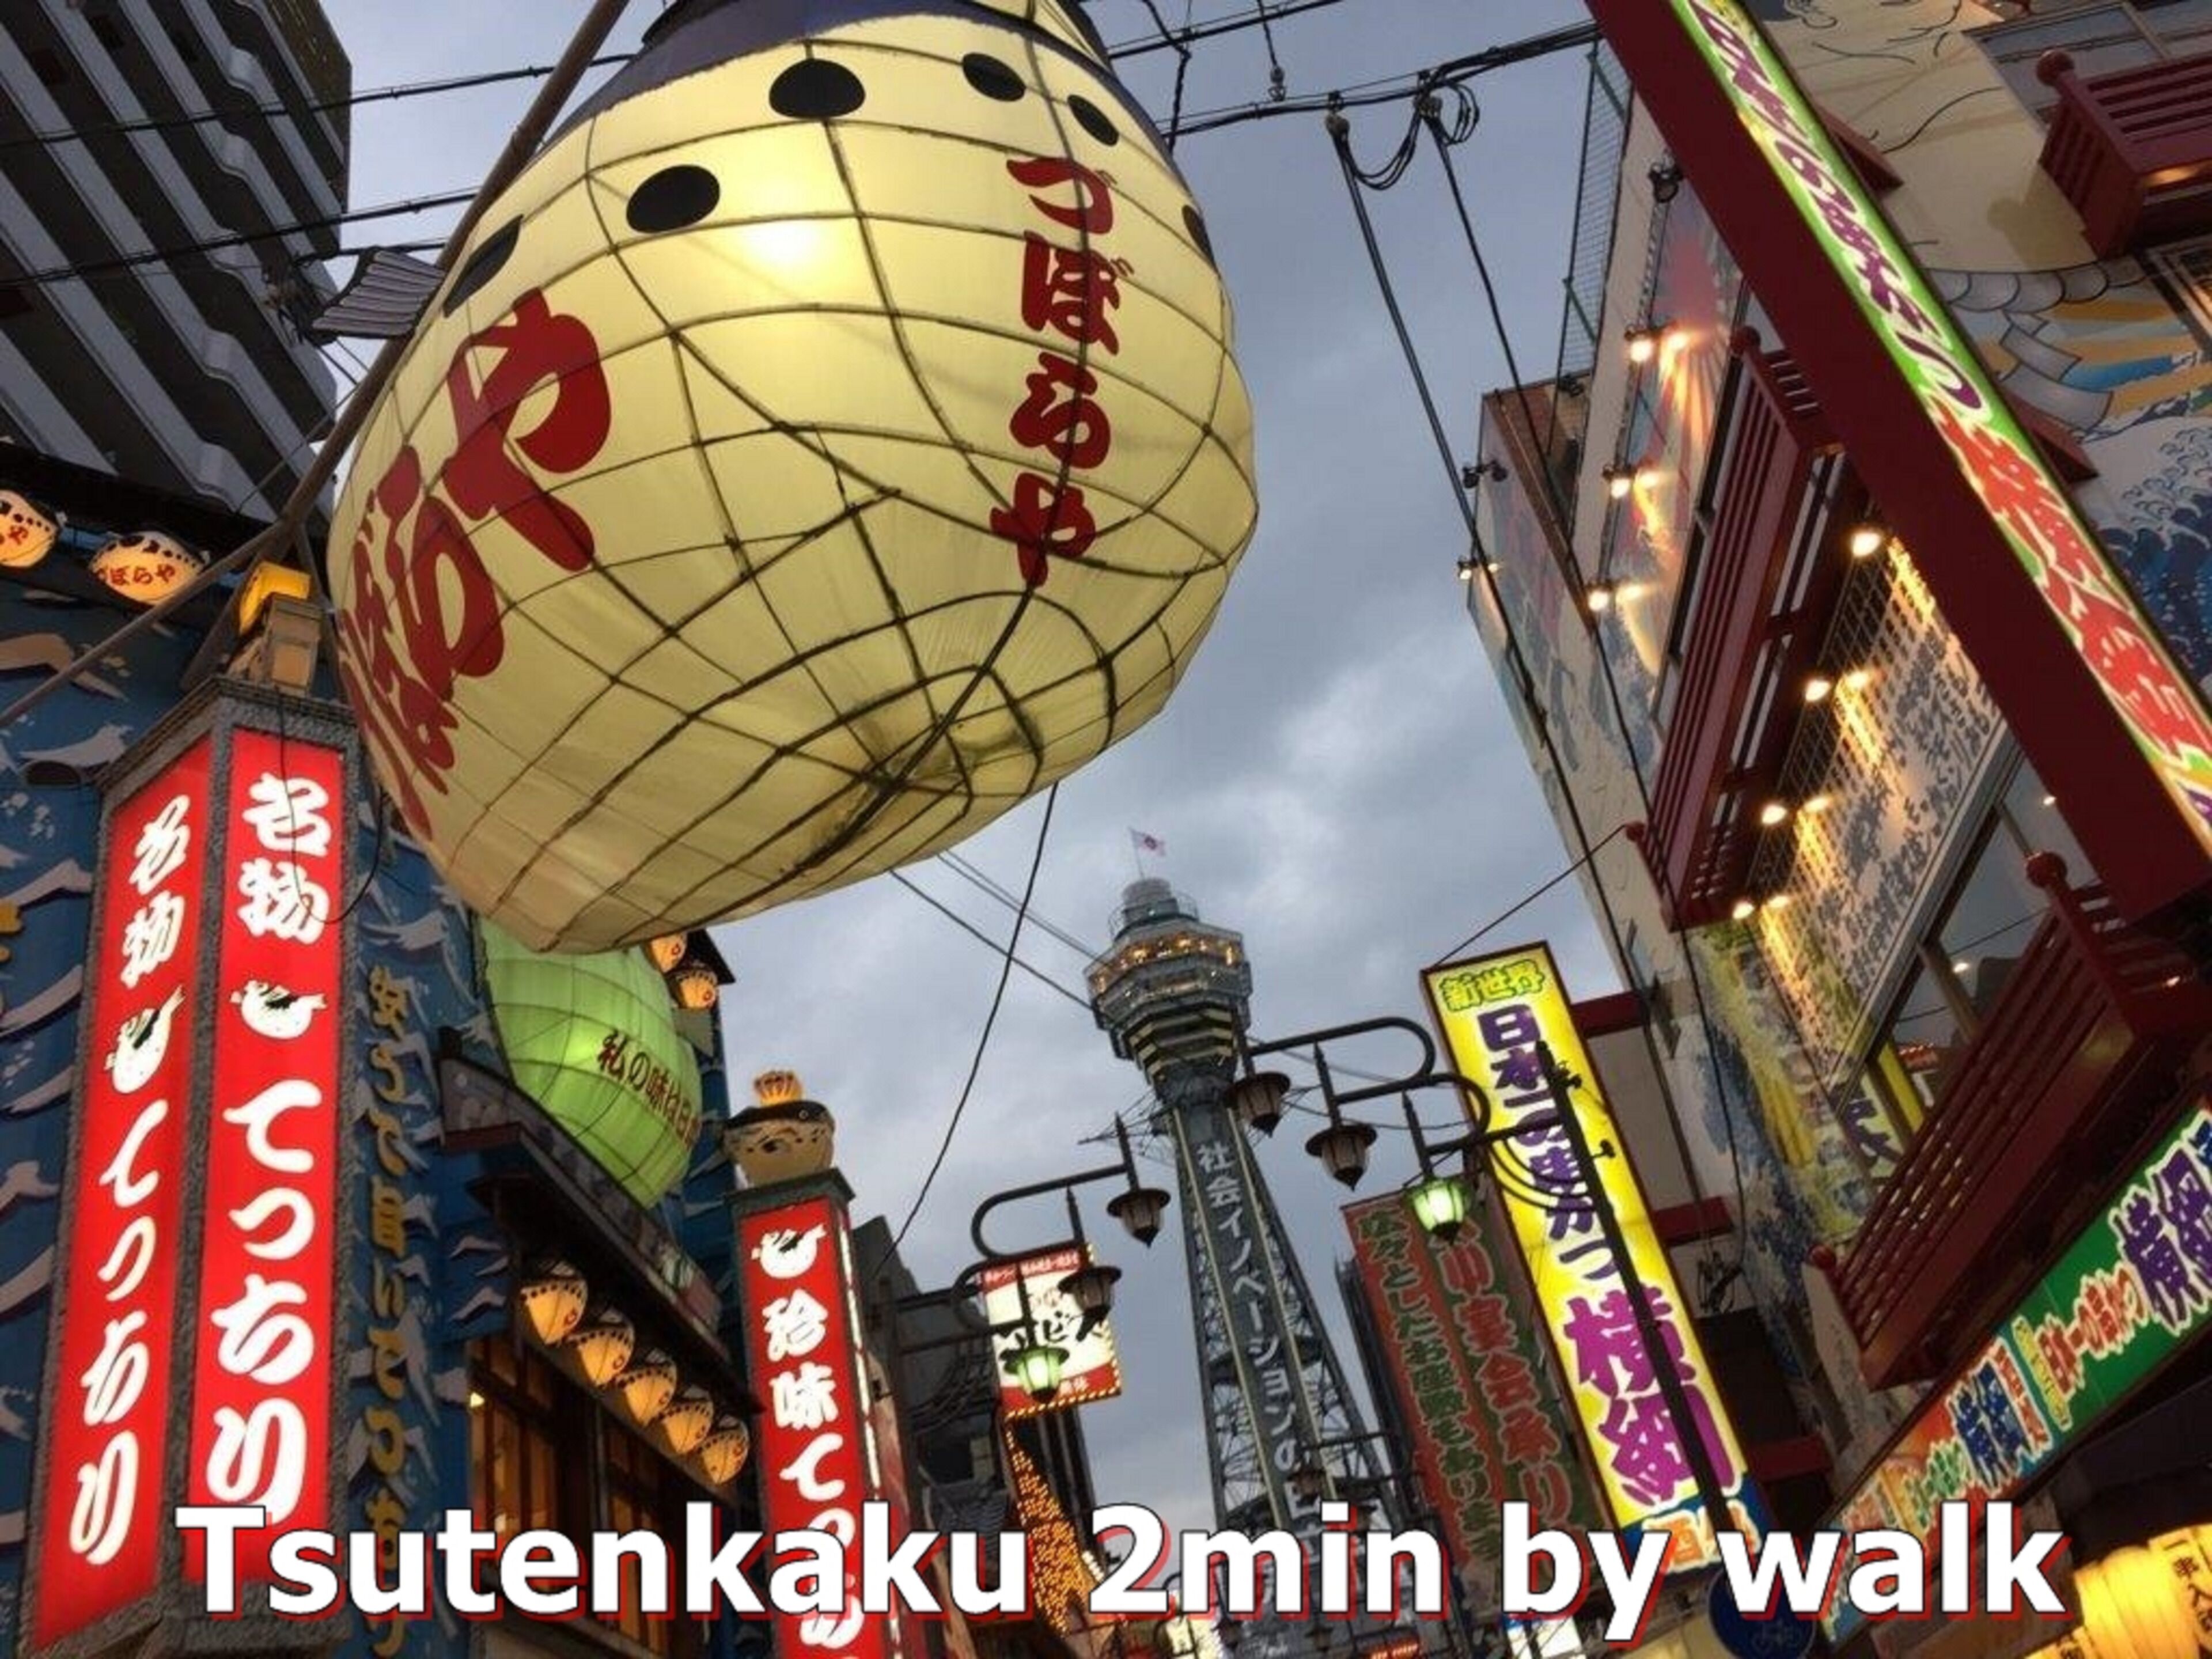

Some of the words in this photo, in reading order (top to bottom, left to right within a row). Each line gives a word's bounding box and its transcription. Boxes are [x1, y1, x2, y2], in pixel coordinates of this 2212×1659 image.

[989, 157, 1135, 588] づぼらや
[1439, 959, 1546, 1013] 新世界
